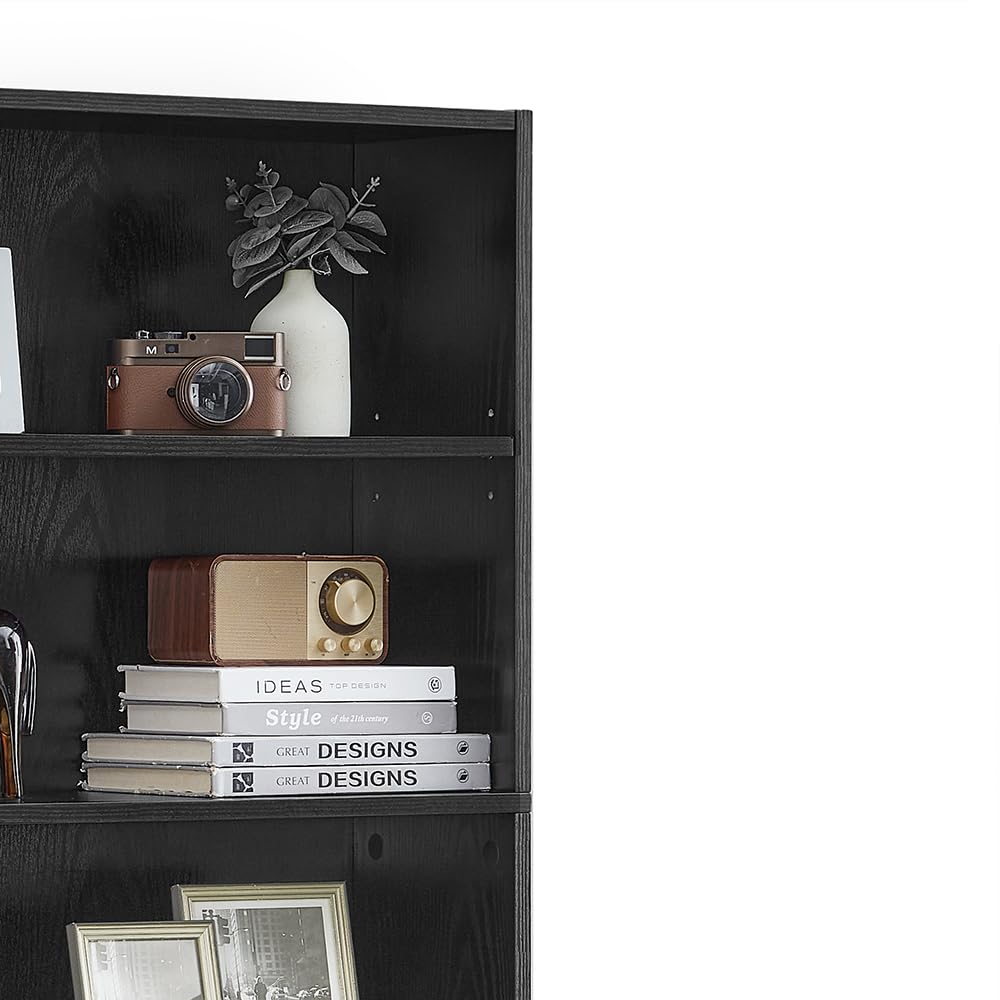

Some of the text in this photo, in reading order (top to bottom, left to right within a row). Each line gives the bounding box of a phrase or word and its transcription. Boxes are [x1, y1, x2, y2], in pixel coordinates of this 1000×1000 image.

[146, 345, 157, 355] M
[256, 679, 323, 694] IDEAS
[265, 708, 322, 730] Style
[330, 714, 339, 725] of
[340, 714, 350, 723] the
[276, 742, 418, 759] GREAT DESIGNS
[276, 770, 418, 788] GREAT DESIGNS
